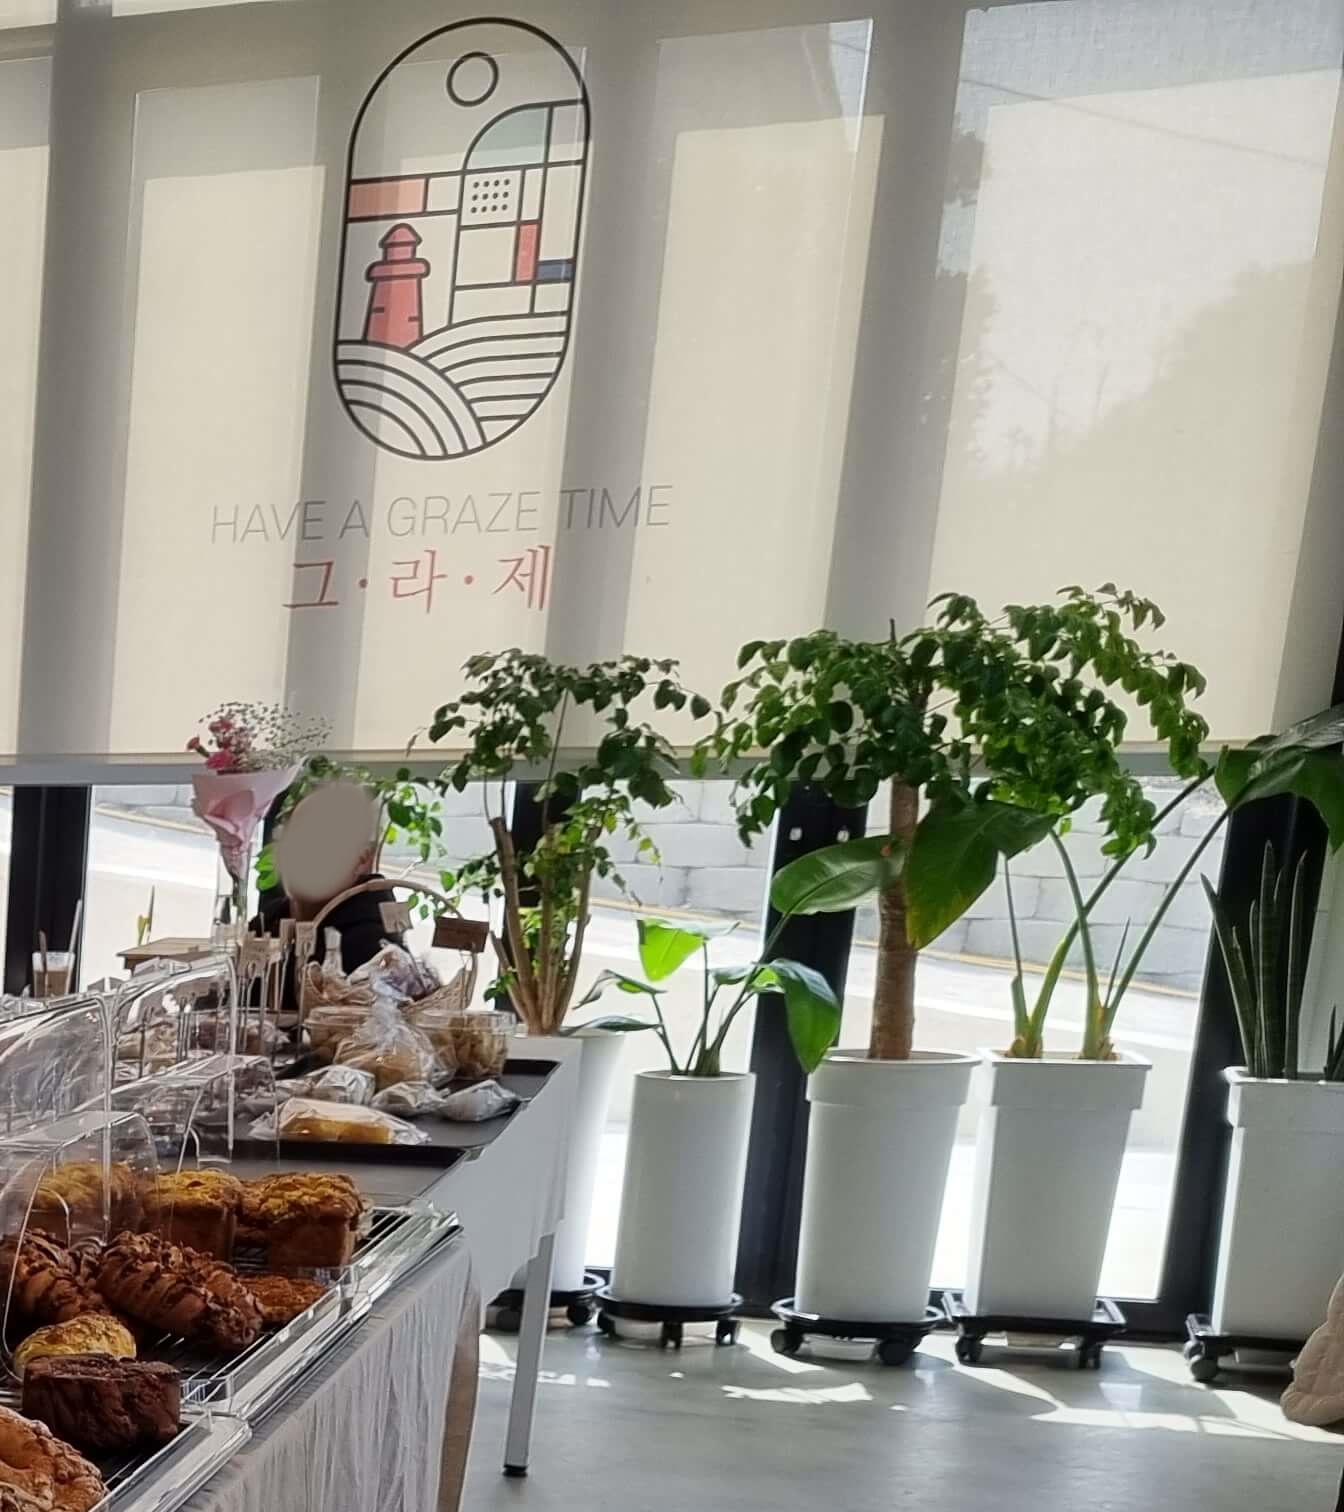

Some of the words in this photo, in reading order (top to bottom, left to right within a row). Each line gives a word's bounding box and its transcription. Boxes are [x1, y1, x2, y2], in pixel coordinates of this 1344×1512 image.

[211, 500, 327, 544] HAVE
[339, 499, 370, 540] A
[386, 491, 541, 537] GRAZE
[559, 484, 674, 530] TIME
